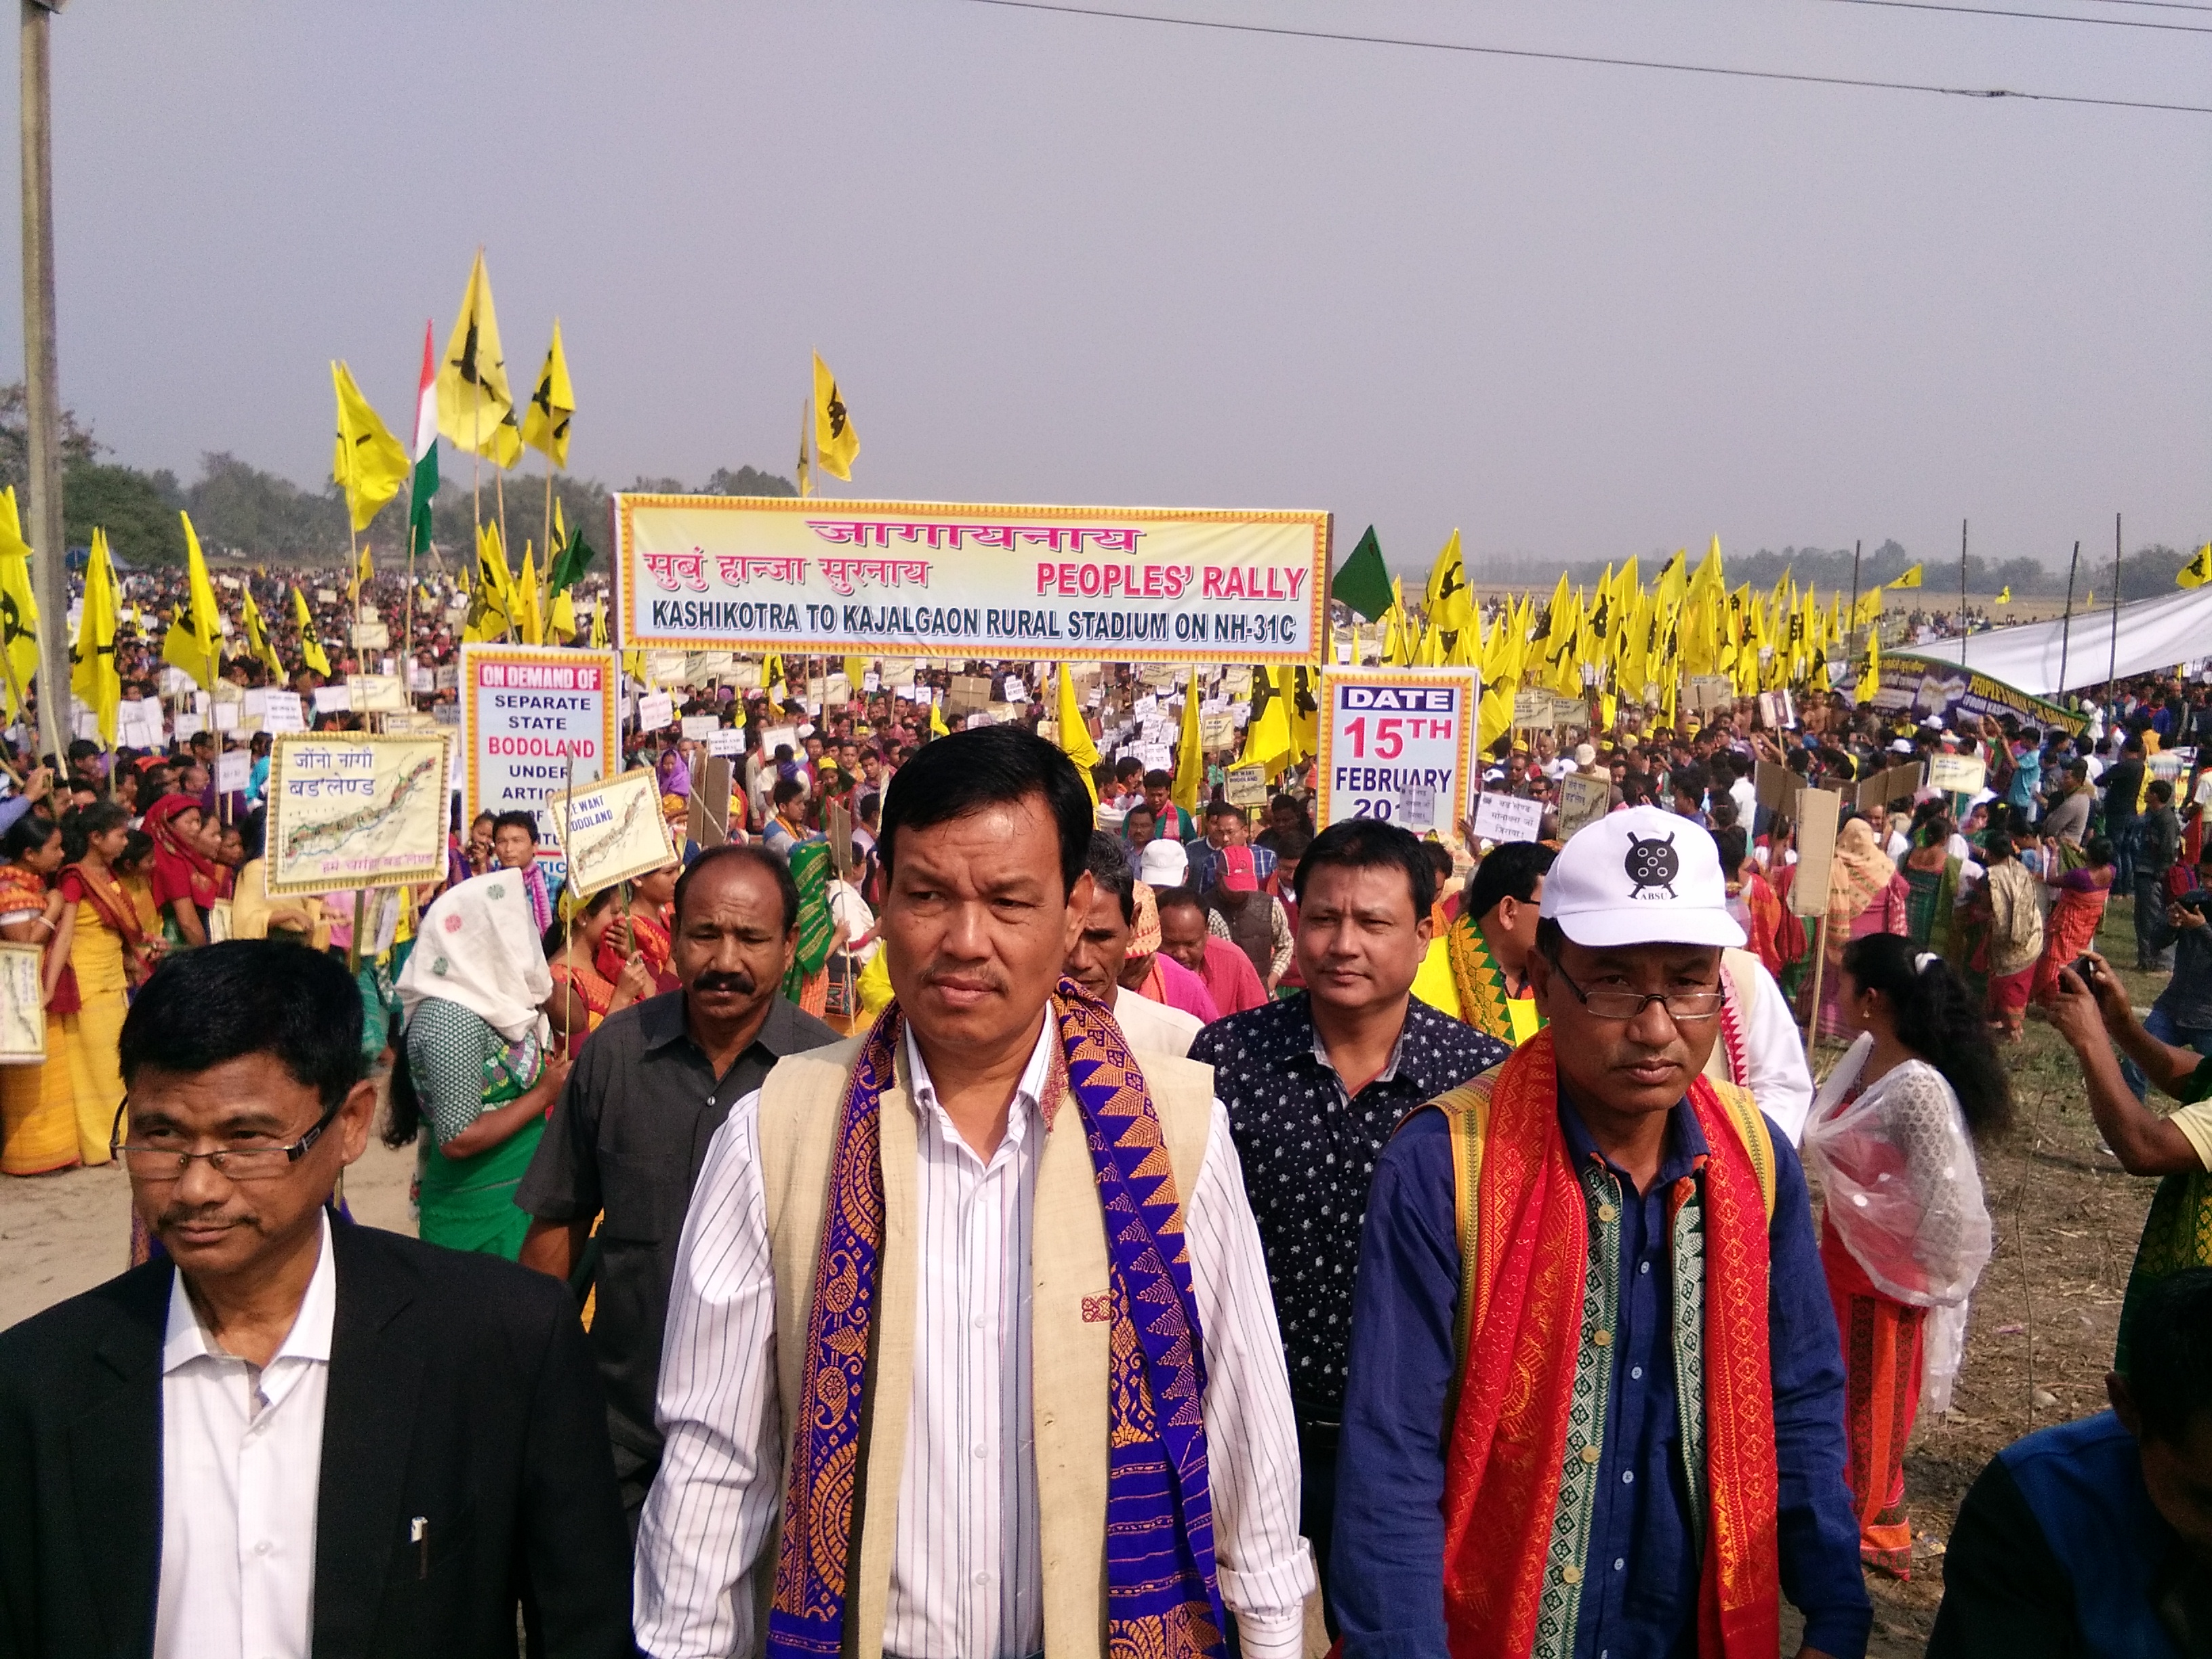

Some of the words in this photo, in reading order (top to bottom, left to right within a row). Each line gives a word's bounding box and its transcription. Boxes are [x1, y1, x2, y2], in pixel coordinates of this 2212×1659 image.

[806, 520, 1146, 553] जागायनाय
[818, 558, 933, 595] सुरनाय
[1202, 566, 1307, 601] RALLY
[653, 600, 802, 632] KASHIKOTRA
[806, 604, 838, 632] TO
[843, 605, 981, 636] KAJALGAON
[987, 608, 1063, 638] RURAL
[1067, 610, 1168, 642] STADIUM
[1175, 613, 1208, 641] ON
[1214, 613, 1296, 643] NH-31C
[483, 665, 505, 686] ON
[508, 666, 574, 689] DEMAND
[578, 669, 598, 690] OF
[495, 694, 591, 711] SEPARATE
[1348, 689, 1450, 710] DATE
[508, 716, 567, 731] STATE
[488, 737, 595, 758] BODOLAND
[1336, 766, 1452, 794] FEBRUARY
[578, 794, 605, 812] WANT
[1640, 892, 1667, 900] ABSU
